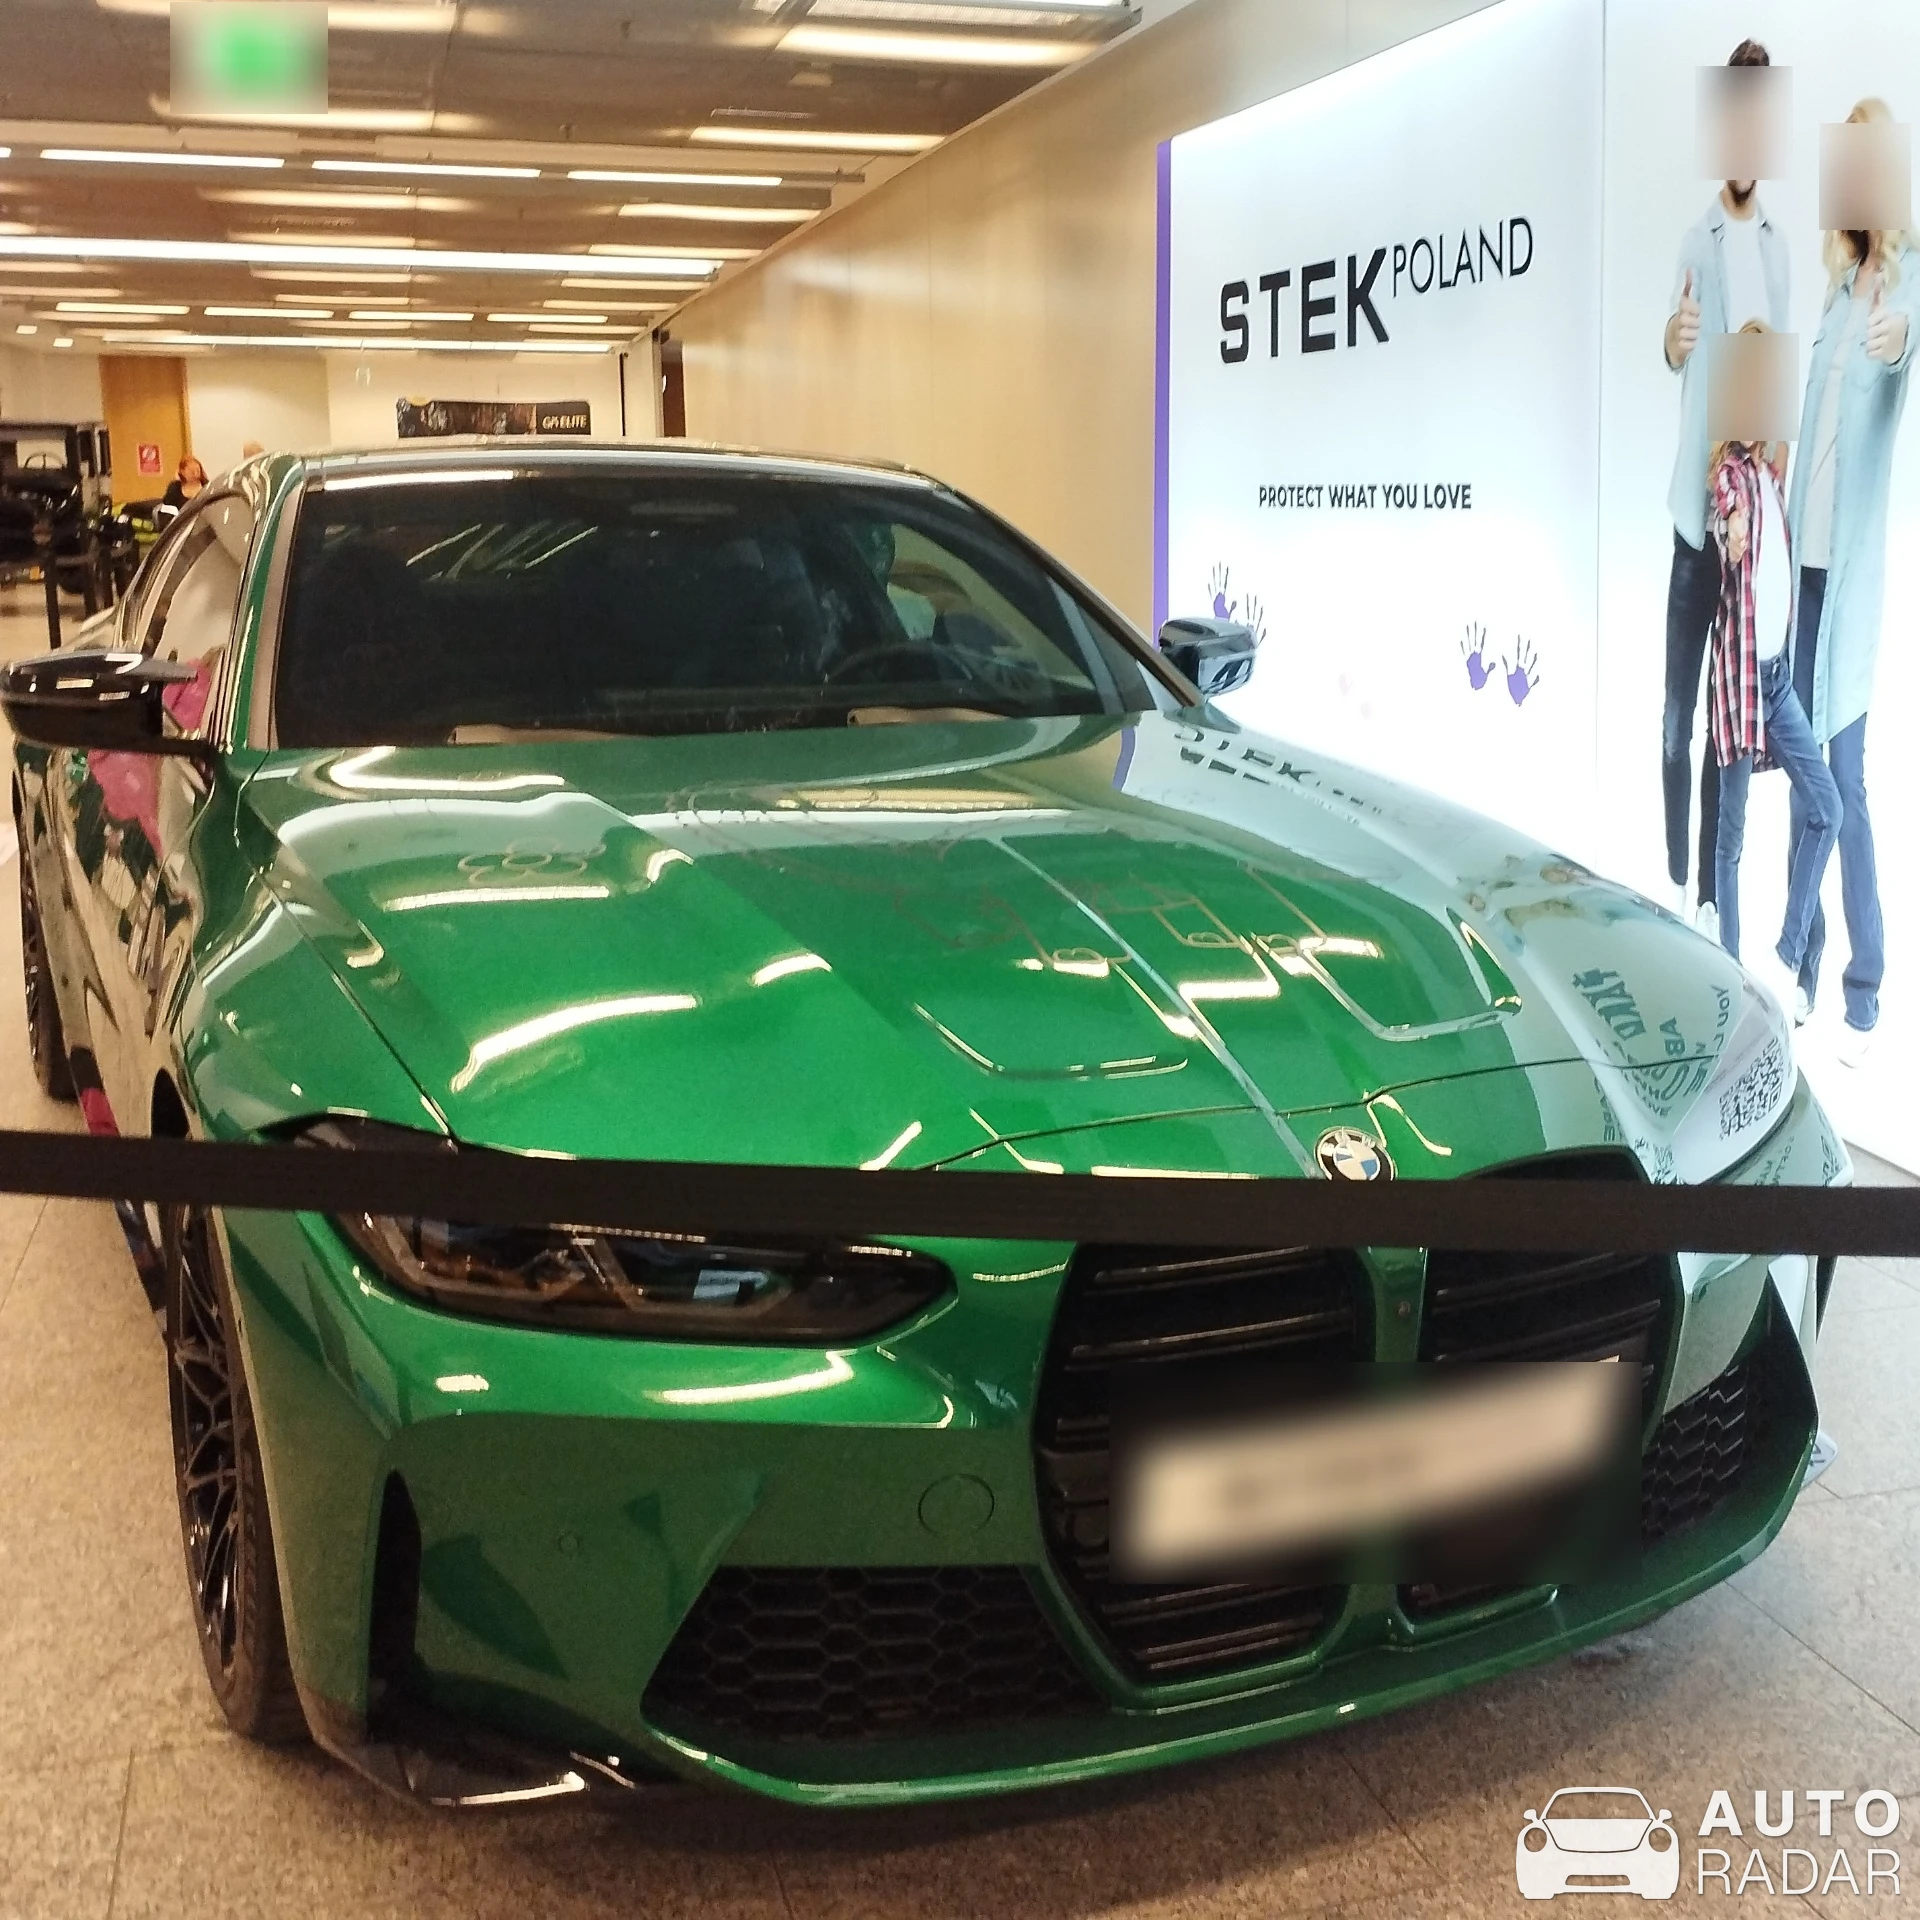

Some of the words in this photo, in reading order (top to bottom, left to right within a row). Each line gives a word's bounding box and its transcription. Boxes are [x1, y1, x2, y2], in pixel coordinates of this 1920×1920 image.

[1220, 247, 1390, 364] STEK
[1393, 217, 1534, 298] POLAND
[560, 414, 587, 429] ELITE
[1259, 485, 1324, 508] PROTECT
[1328, 485, 1378, 509] WHAT
[1382, 484, 1418, 509] YOU
[1423, 484, 1472, 510] LOVE
